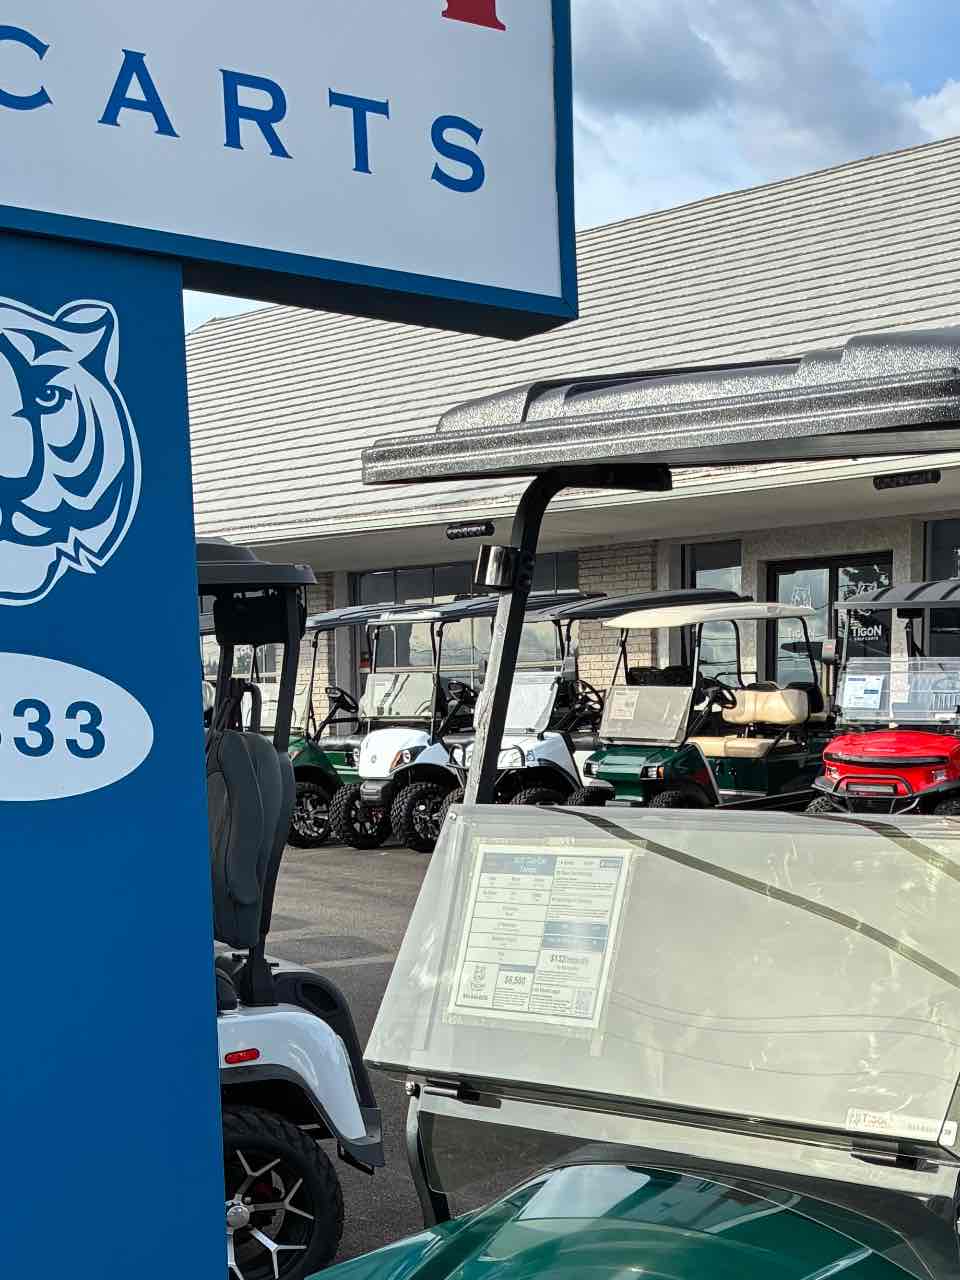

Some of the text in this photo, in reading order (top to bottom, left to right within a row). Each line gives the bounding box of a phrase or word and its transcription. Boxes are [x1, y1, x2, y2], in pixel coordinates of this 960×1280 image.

[0, 24, 486, 193] CARTS
[850, 624, 883, 637] TIGON
[0, 698, 106, 759] 33
